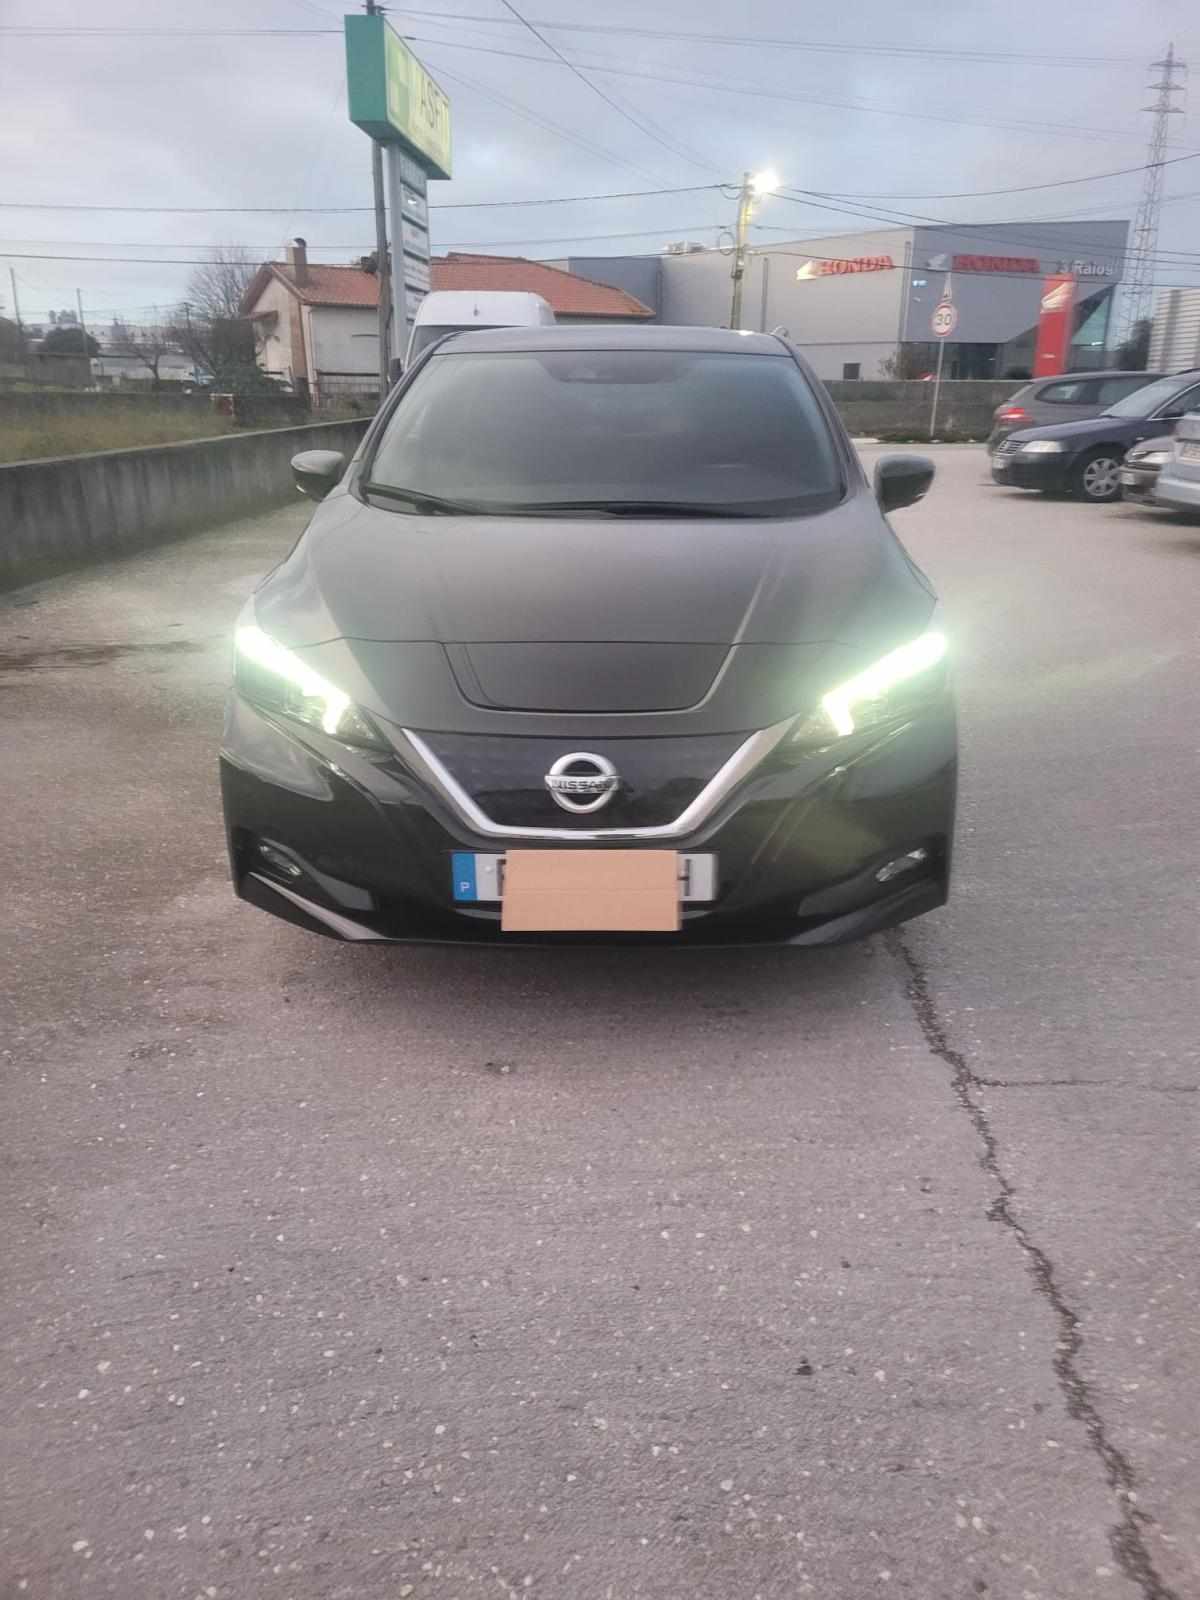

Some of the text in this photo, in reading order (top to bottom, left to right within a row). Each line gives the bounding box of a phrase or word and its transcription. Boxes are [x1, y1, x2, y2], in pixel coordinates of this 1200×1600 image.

[817, 255, 893, 275] HONDA
[936, 313, 952, 326] 30
[460, 881, 471, 893] P
